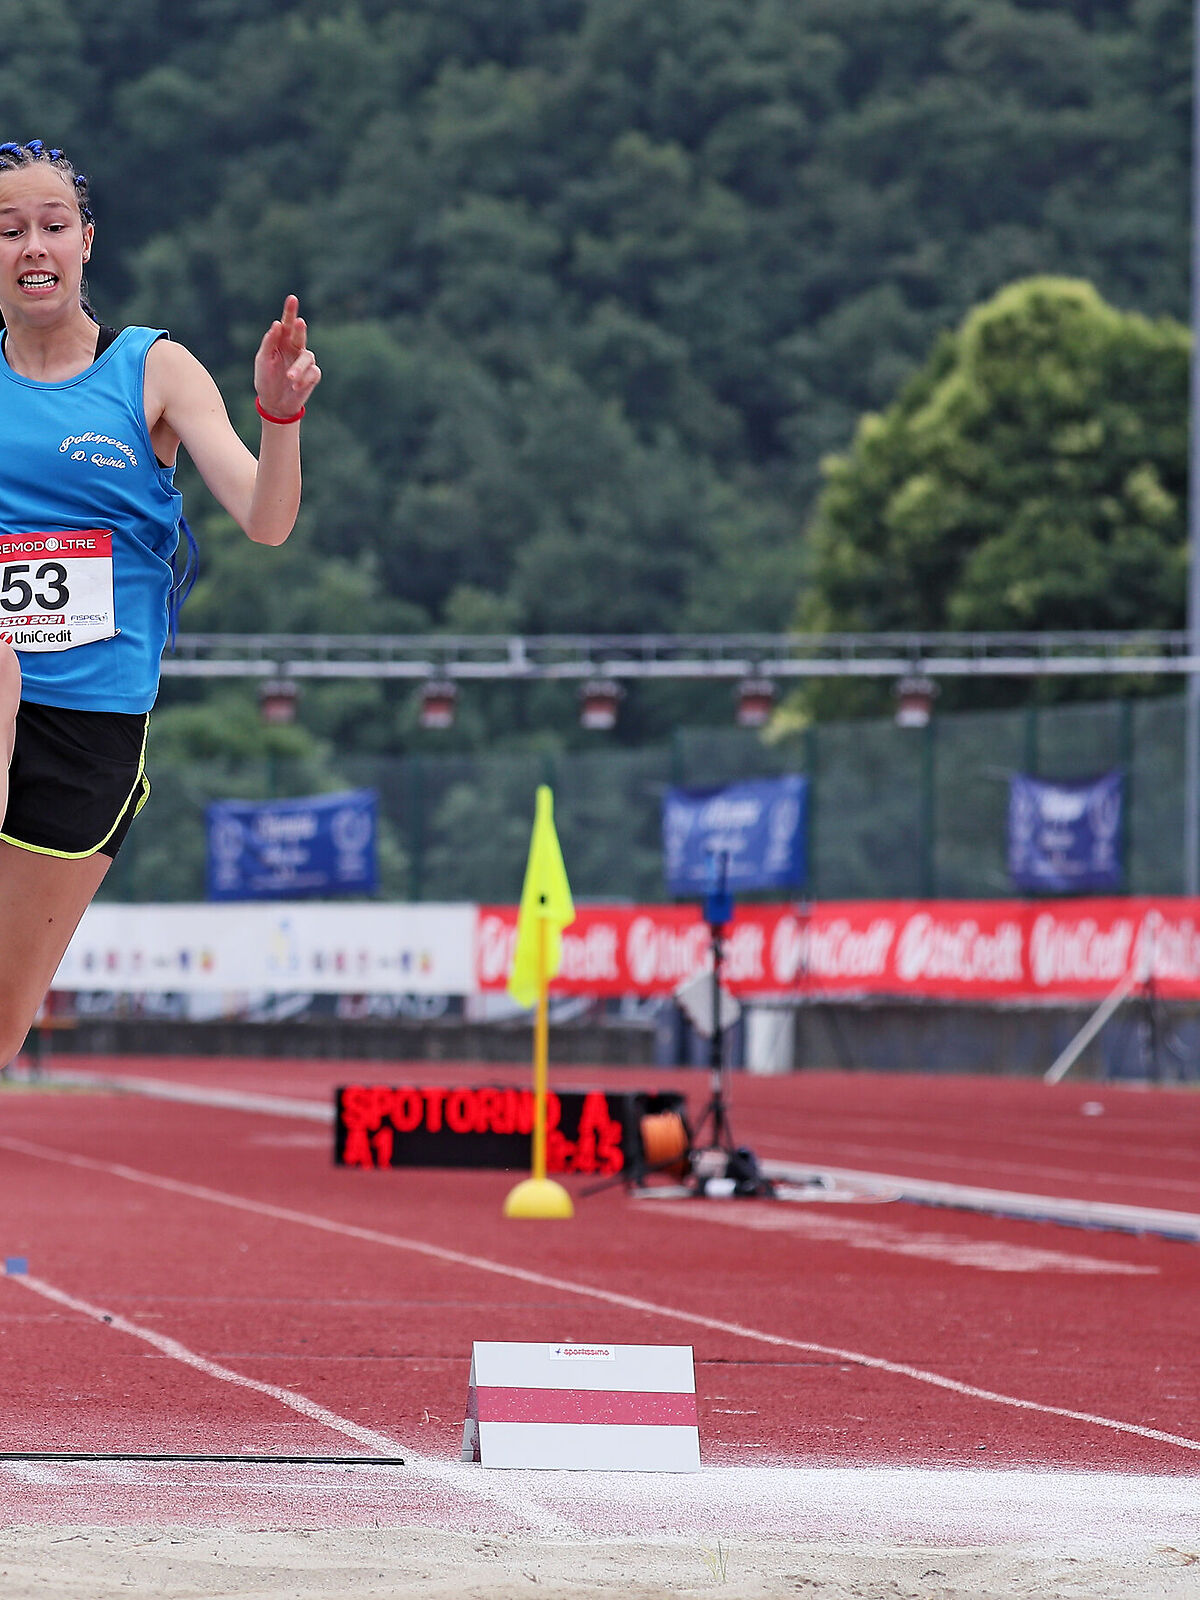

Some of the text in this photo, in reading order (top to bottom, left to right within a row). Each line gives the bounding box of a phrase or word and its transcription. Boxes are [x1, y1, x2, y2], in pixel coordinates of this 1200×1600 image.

[59, 432, 137, 467] Polisportiva
[91, 454, 126, 469] Quinto
[0, 562, 70, 612] 53
[29, 615, 64, 626] 2021
[15, 630, 72, 645] UniCredit
[343, 1126, 394, 1171] A1
[563, 1348, 610, 1357] sportissimo
